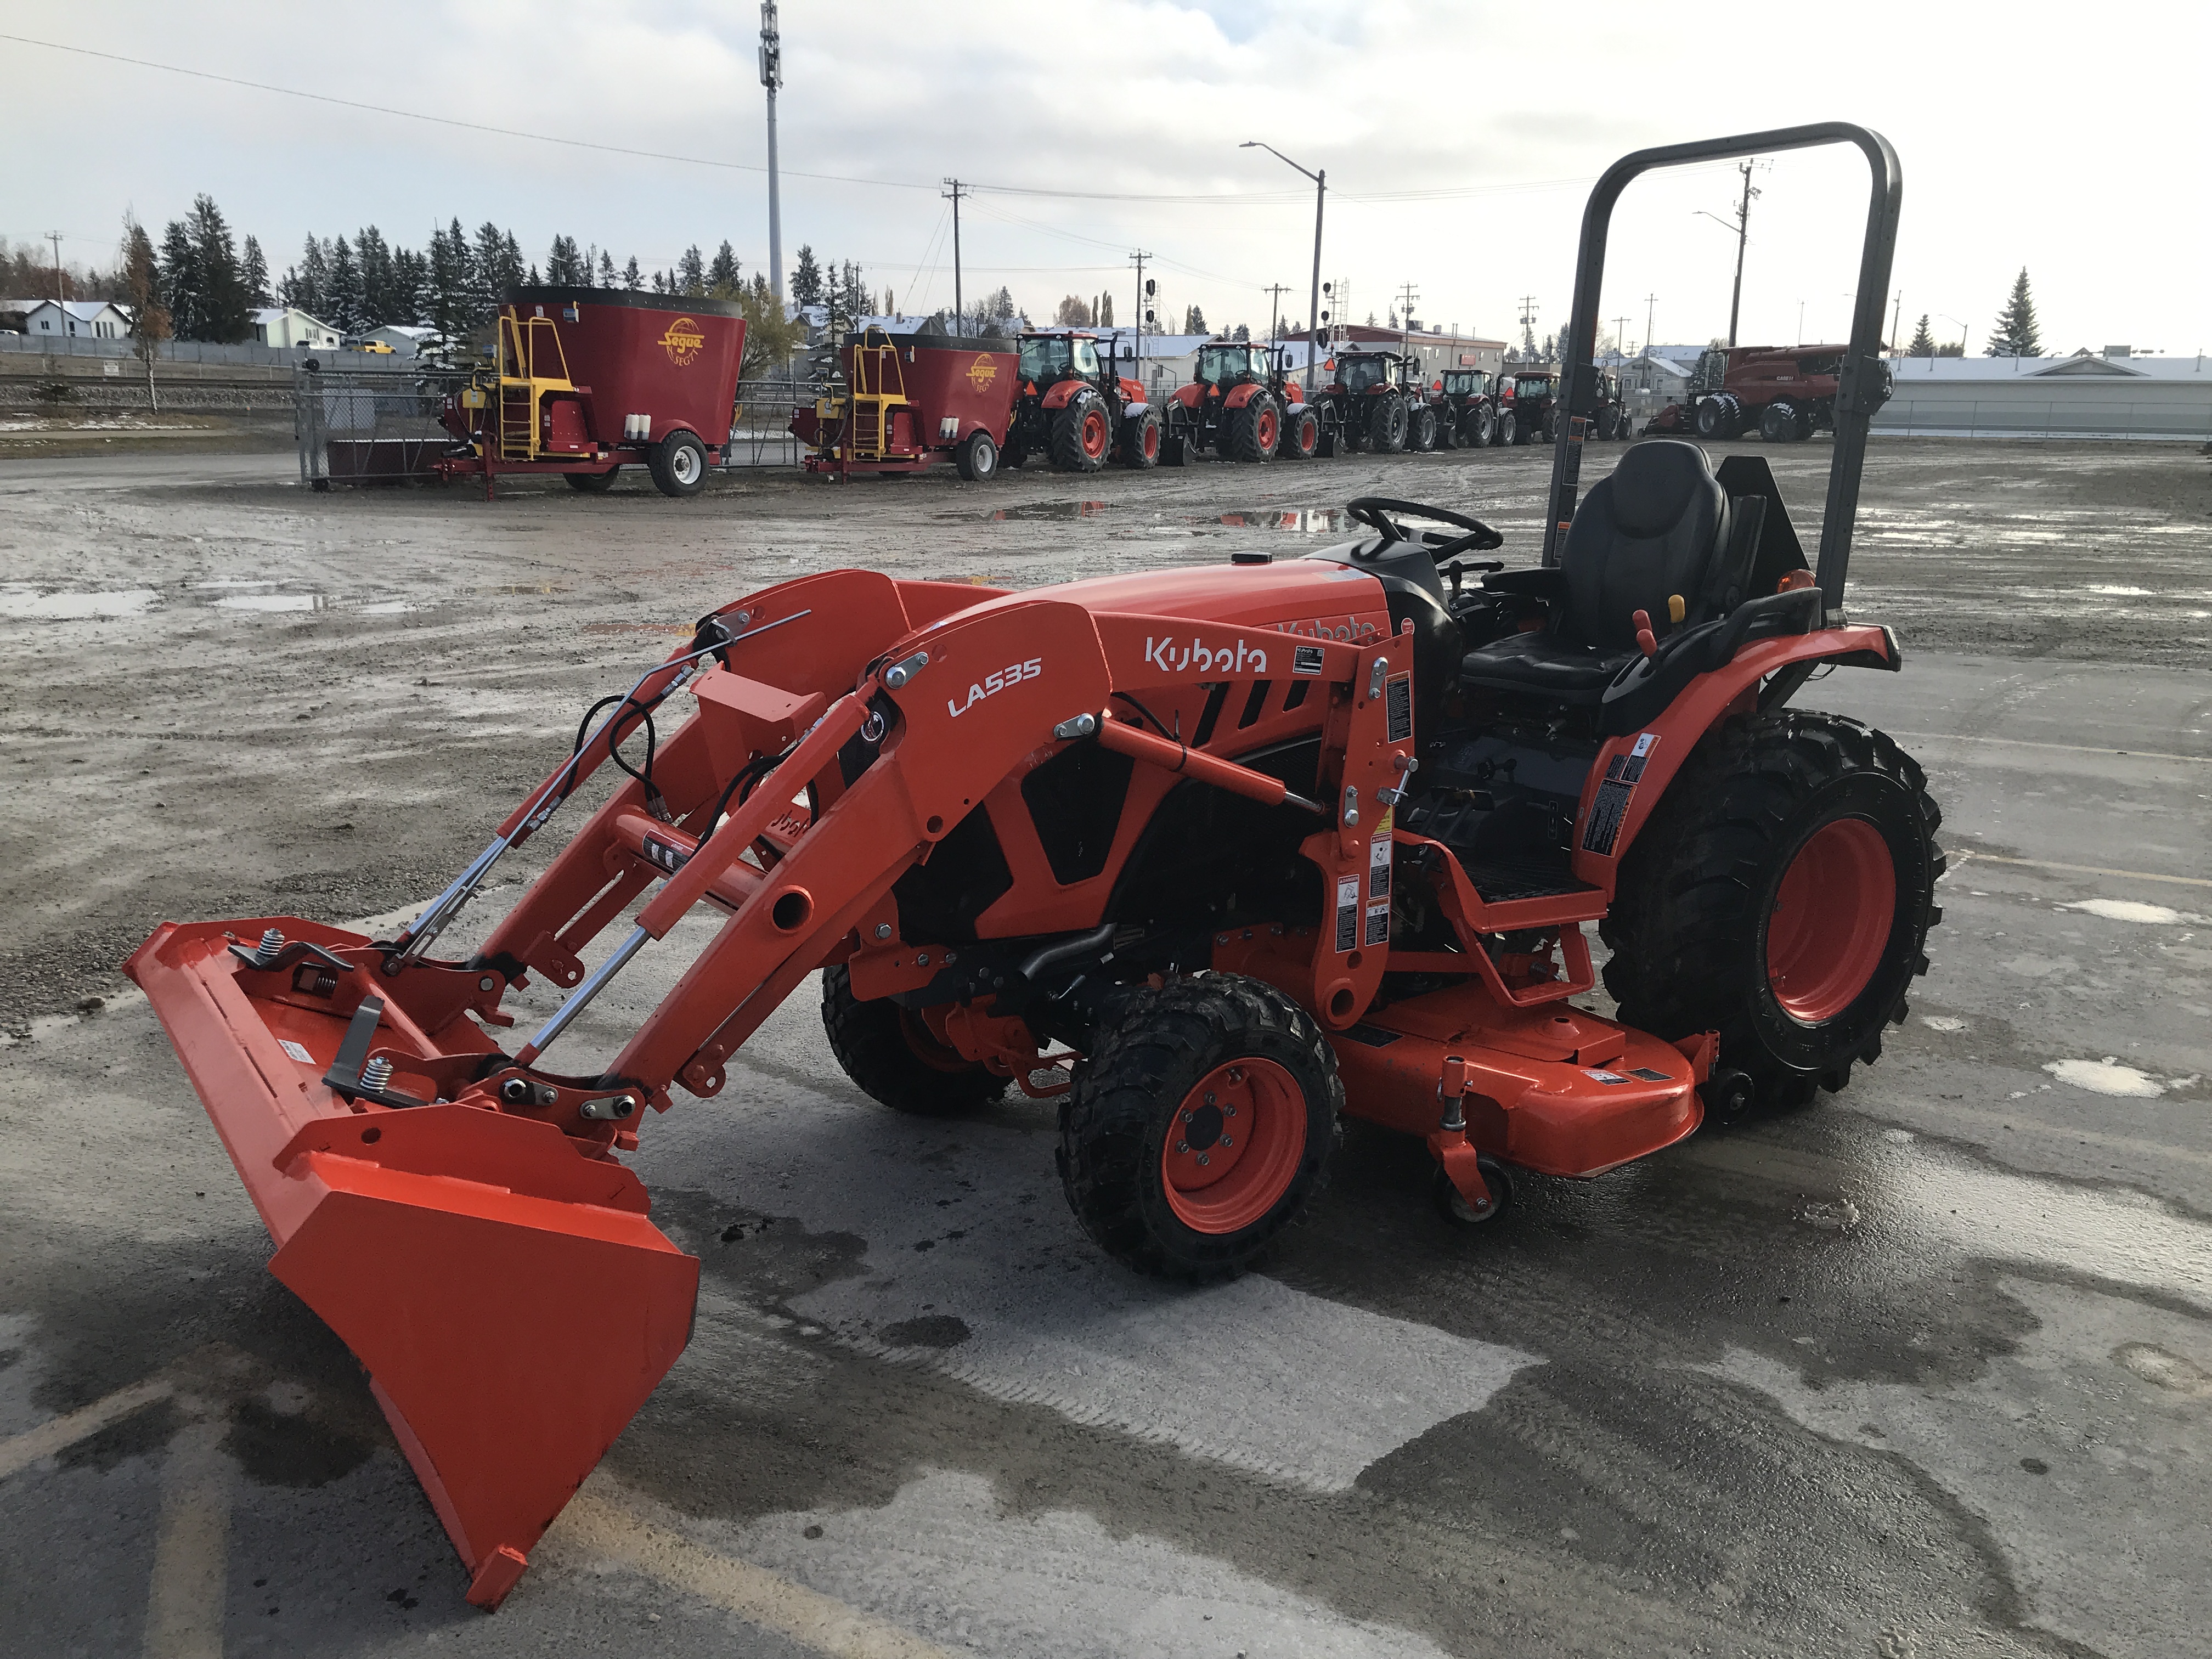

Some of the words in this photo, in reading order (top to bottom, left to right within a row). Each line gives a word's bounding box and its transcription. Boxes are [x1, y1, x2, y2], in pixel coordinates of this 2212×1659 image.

[657, 332, 705, 354] Segue
[966, 366, 997, 383] Segue
[1145, 636, 1267, 673] Kubota
[947, 657, 1042, 718] LA535
